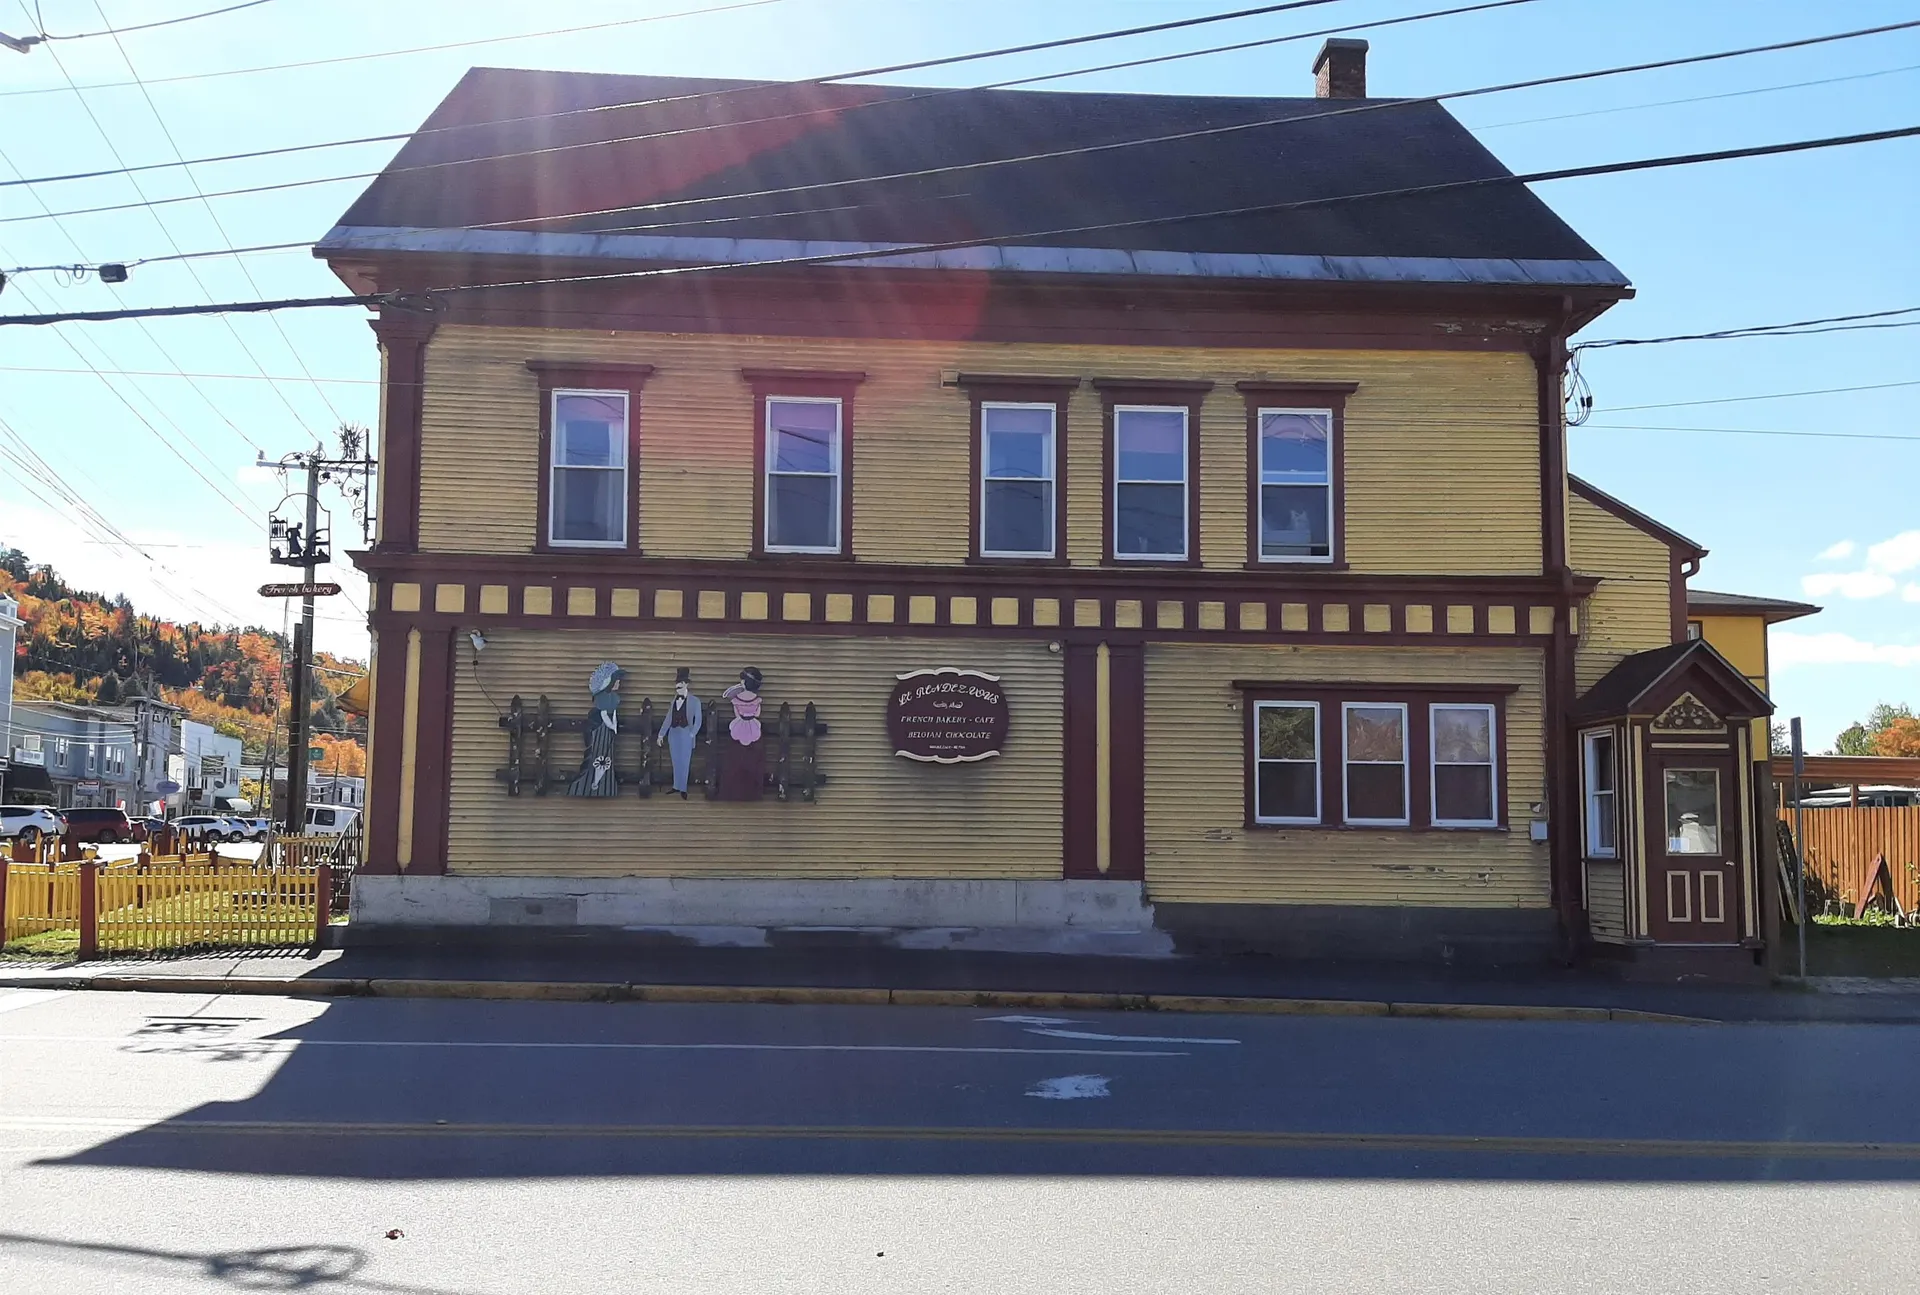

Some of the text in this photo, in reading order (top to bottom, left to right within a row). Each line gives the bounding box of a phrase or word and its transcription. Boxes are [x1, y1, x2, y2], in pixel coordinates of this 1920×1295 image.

[301, 584, 333, 595] bakery
[898, 691, 913, 706] LE
[900, 715, 934, 723] FRENCH
[936, 716, 967, 724] BAKERY
[907, 731, 992, 740] BELGIAN CHOCOLATE
